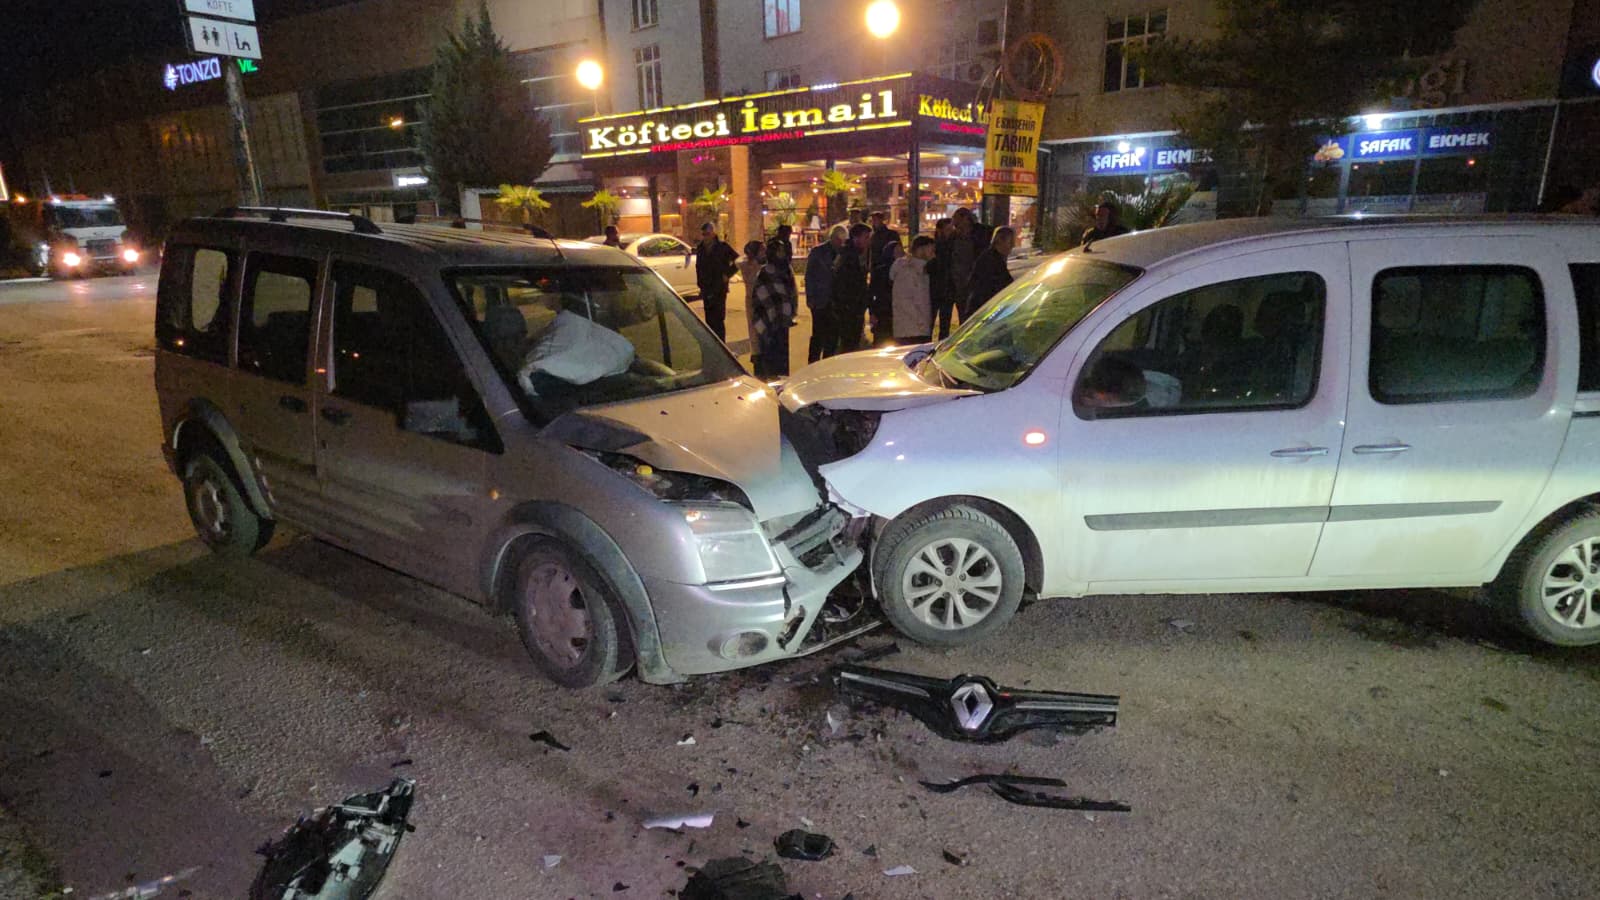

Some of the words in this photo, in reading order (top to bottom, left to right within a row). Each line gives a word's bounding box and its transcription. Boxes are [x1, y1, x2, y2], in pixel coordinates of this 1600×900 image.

[918, 93, 973, 122] Köfteci
[588, 113, 730, 150] Köfteci
[741, 89, 898, 133] İsmail
[994, 134, 1034, 154] TARIM
[1359, 137, 1412, 155] ŞAFAK
[1429, 132, 1490, 149] EKMEK
[1092, 151, 1142, 171] ŞAFAK
[1157, 149, 1213, 165] EKMK
